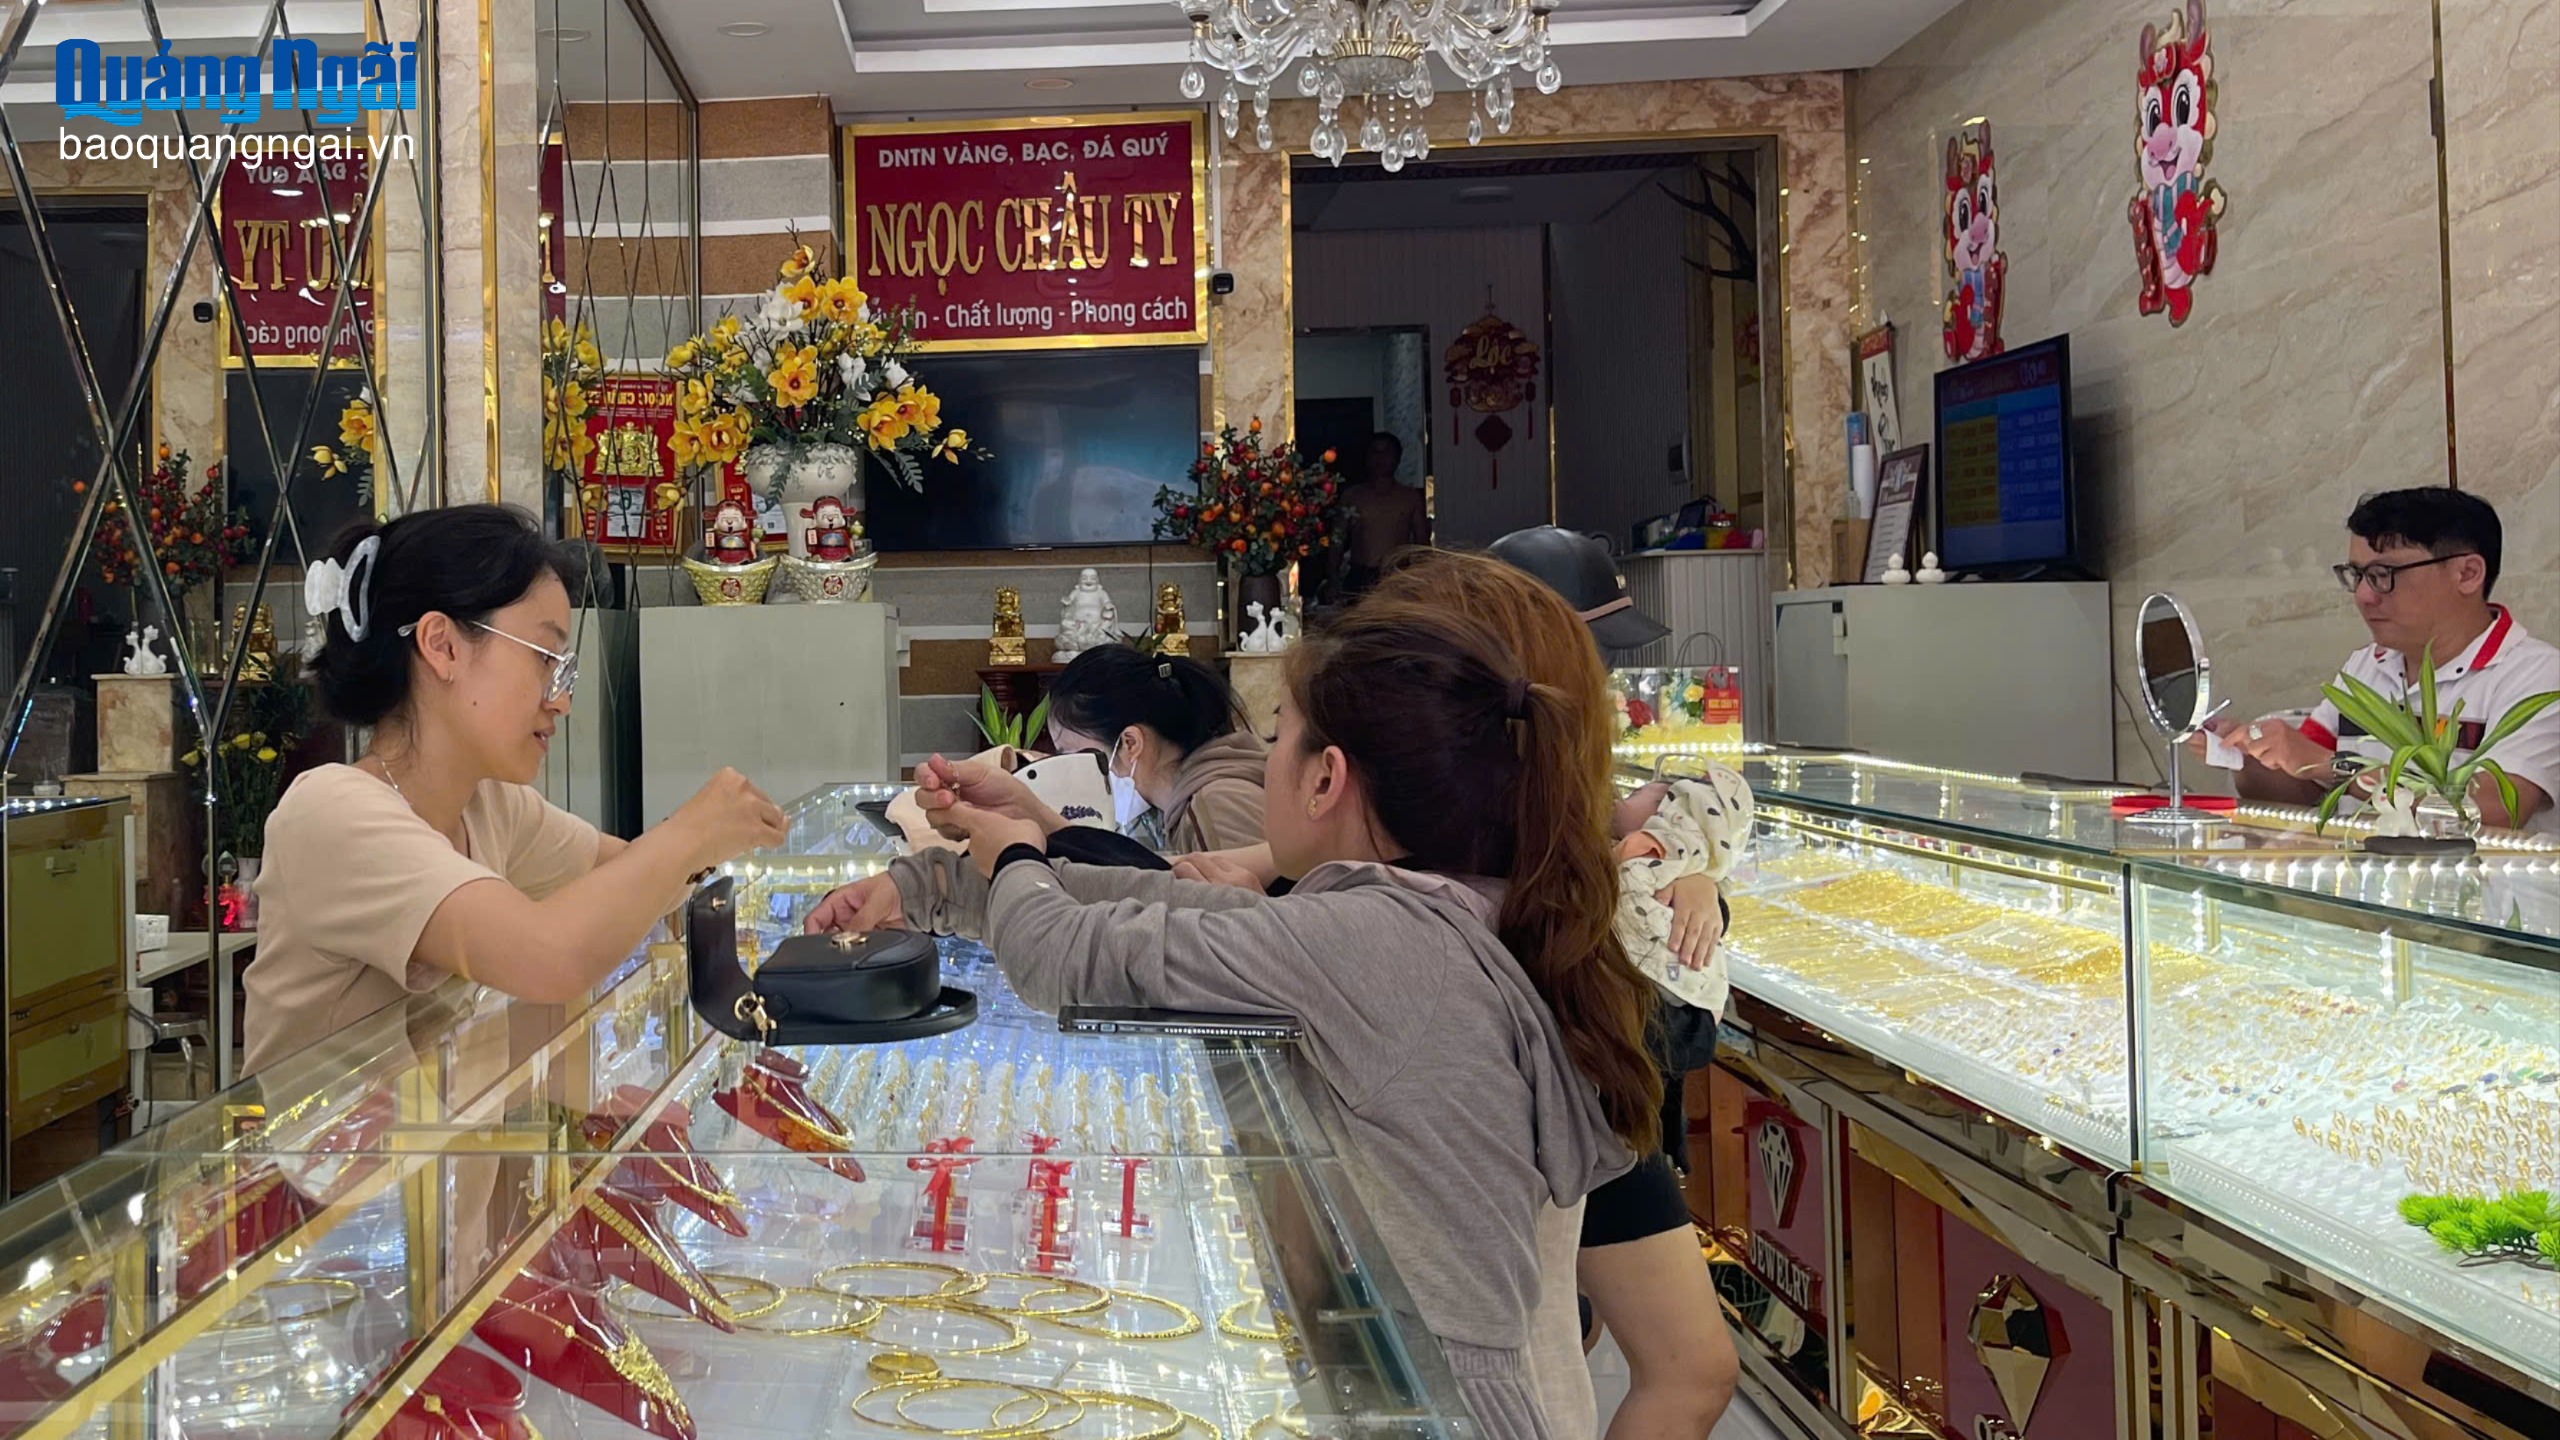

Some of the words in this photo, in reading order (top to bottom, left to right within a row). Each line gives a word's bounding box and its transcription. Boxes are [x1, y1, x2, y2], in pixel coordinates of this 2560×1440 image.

[879, 148, 936, 167] DNTN
[943, 141, 1014, 165] VÀNG,
[1022, 142, 1075, 166] BẠC,
[1083, 134, 1115, 158] ĐÁ
[1122, 131, 1169, 157] QUÝ
[866, 200, 985, 296] NGỌC
[995, 172, 1112, 272] CHÂU
[1124, 192, 1181, 268] TY
[945, 299, 991, 327] Chất
[997, 302, 1052, 330] lượng
[1071, 299, 1136, 325] Phong
[1141, 296, 1188, 321] cách
[1750, 1231, 1810, 1311] JEWELRY
